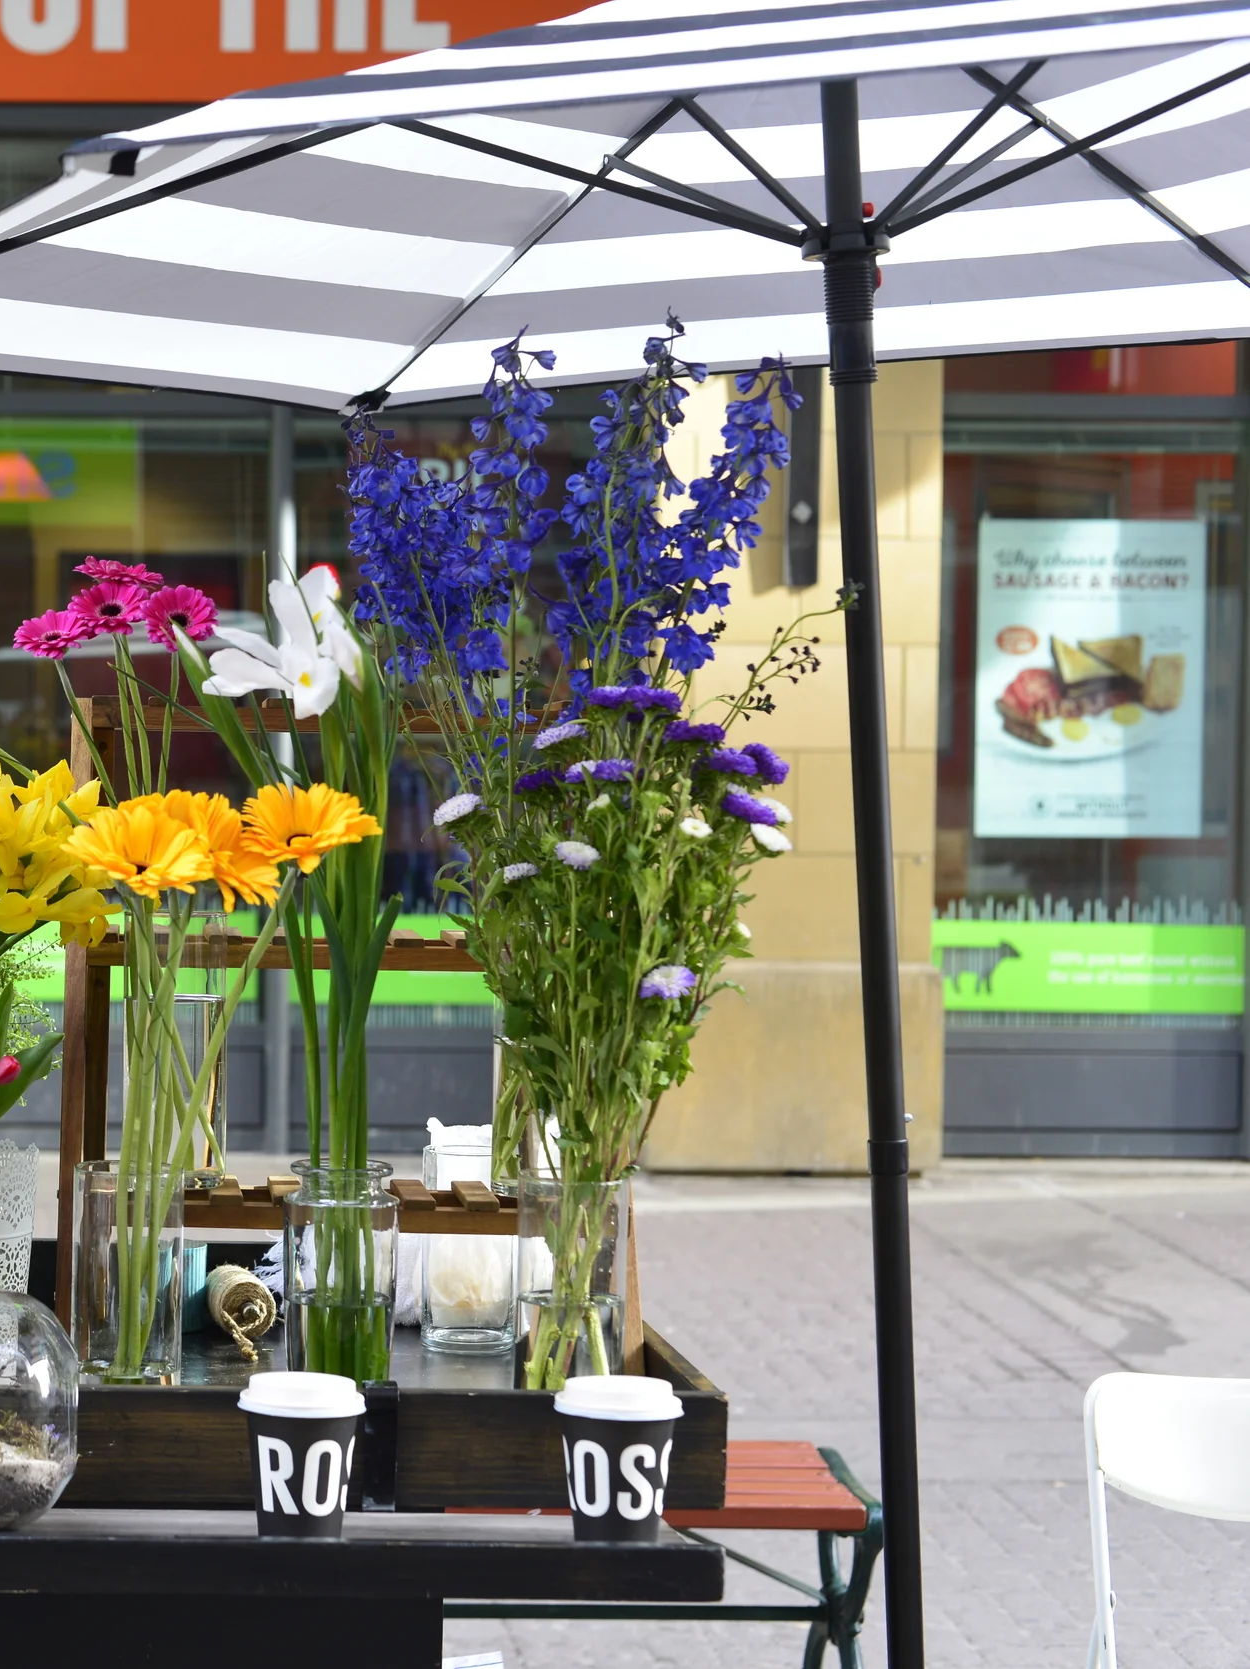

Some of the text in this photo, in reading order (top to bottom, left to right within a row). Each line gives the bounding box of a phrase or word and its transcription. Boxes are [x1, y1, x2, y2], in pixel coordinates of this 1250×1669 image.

[0, 0, 128, 54] O
[993, 572, 1081, 590] SAUSAGE
[562, 1434, 673, 1521] OS
